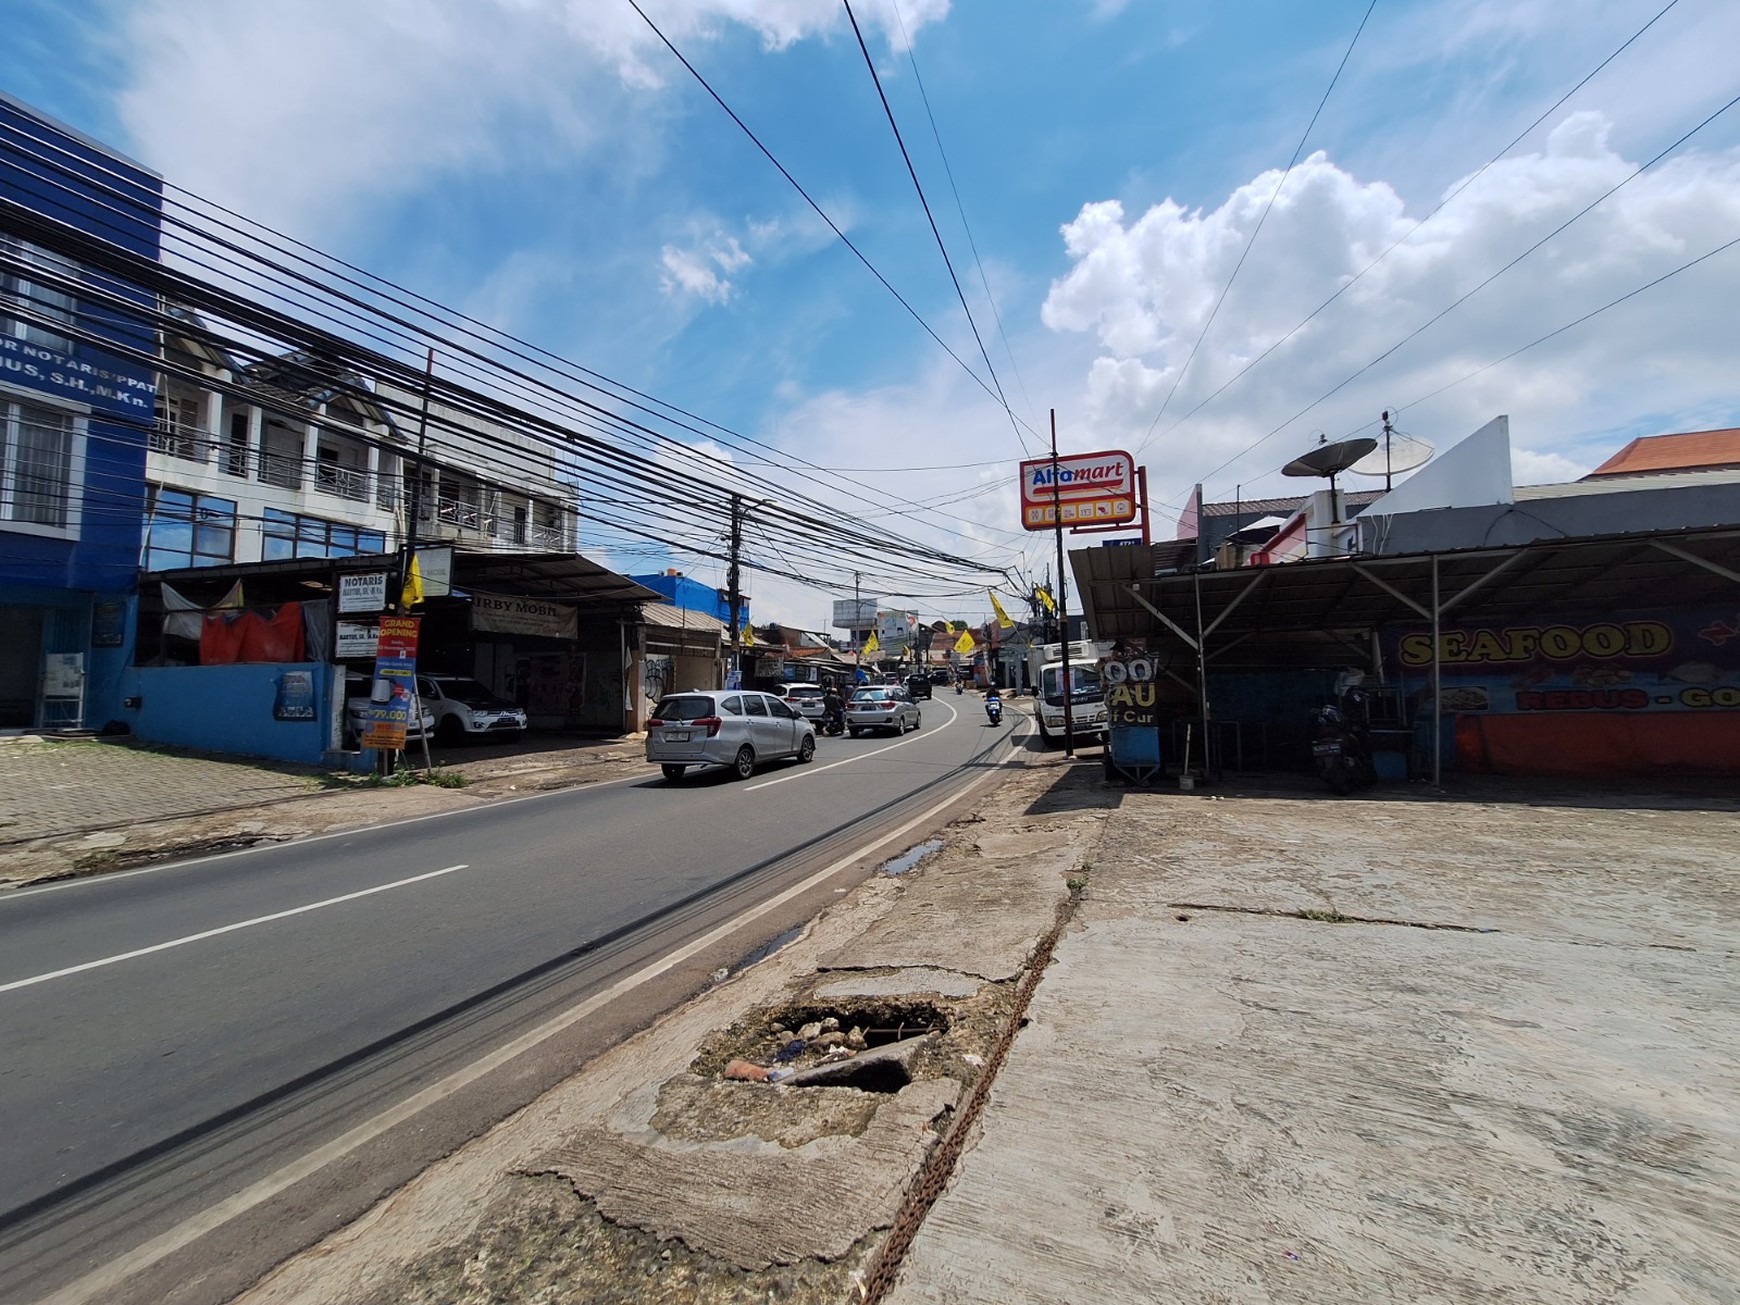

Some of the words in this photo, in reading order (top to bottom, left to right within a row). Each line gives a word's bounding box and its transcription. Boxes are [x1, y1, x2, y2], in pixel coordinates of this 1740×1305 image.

[344, 576, 384, 588] NOTARIS
[515, 603, 558, 617] MOBIL
[384, 619, 415, 629] GRAND
[379, 628, 418, 638] OPENING
[1400, 621, 1670, 665] SEAFOOD
